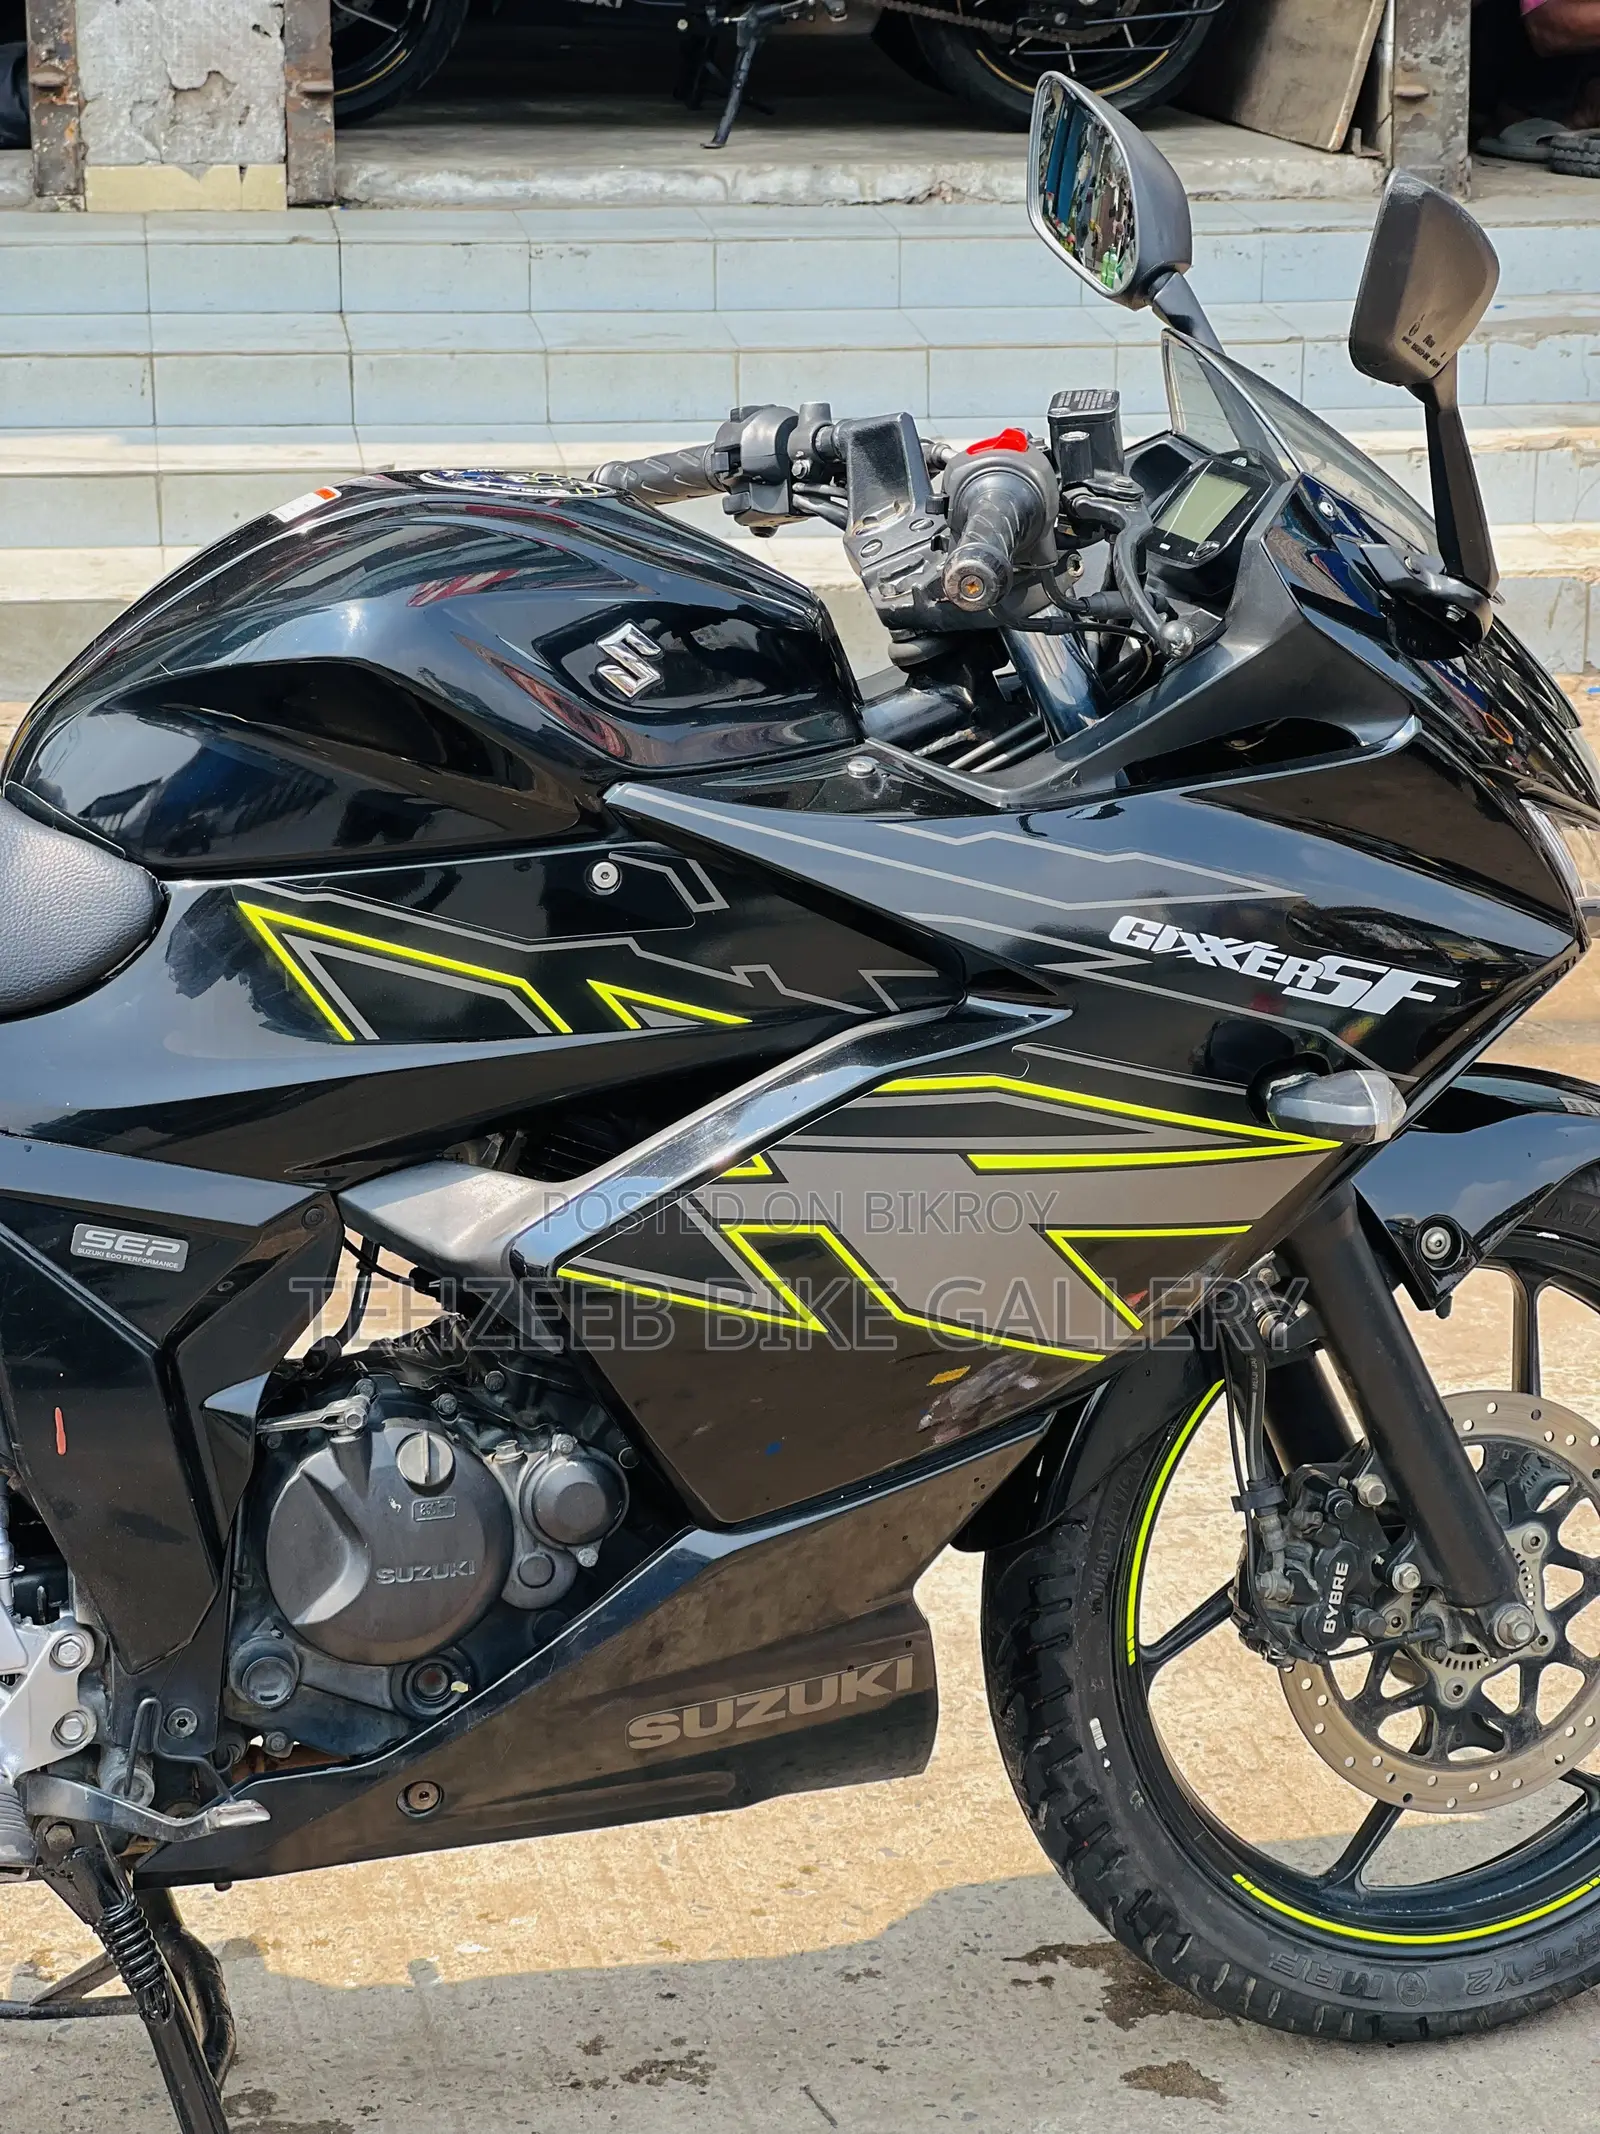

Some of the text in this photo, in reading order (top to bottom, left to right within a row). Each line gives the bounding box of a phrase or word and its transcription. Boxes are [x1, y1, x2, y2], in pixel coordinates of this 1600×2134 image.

[80, 1229, 181, 1257] SEP
[77, 1247, 180, 1270] SUZUKI ECO PERFORMANCE
[375, 1560, 476, 1584] SUZUKI
[1322, 1562, 1349, 1634] BYBRE
[628, 1655, 914, 1750] SUZUKI
